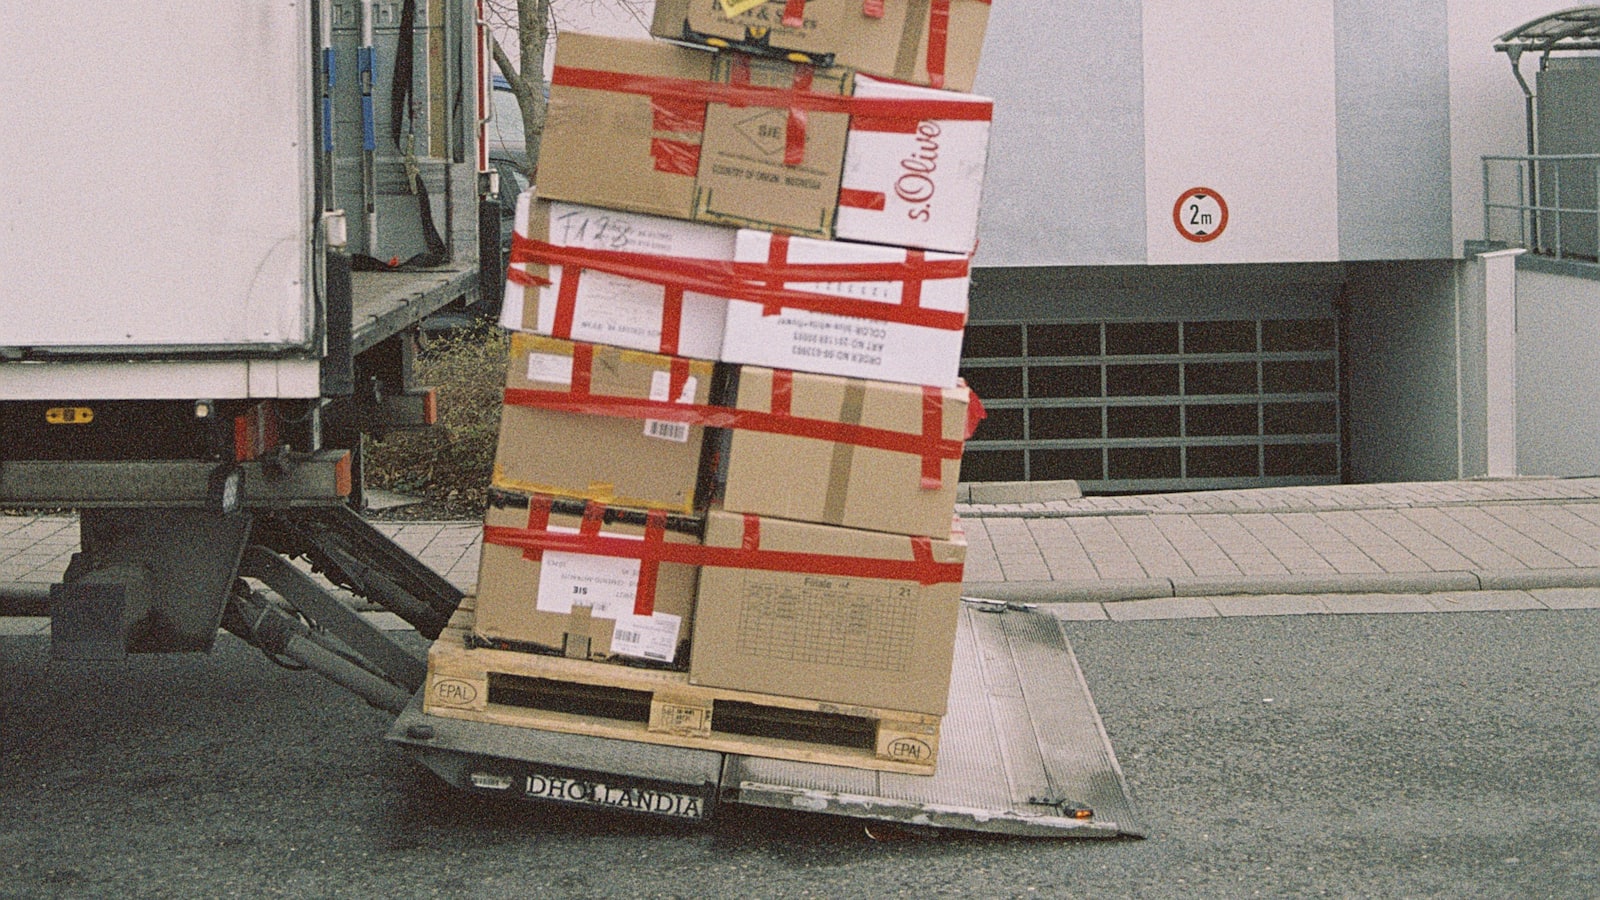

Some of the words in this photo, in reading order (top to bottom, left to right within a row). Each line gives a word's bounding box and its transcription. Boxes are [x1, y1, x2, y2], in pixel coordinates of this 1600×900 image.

[894, 120, 941, 223] s.Olive
[572, 585, 589, 596] SIE
[439, 683, 469, 700] EPAL
[526, 773, 702, 819] DHOLLANDIA
